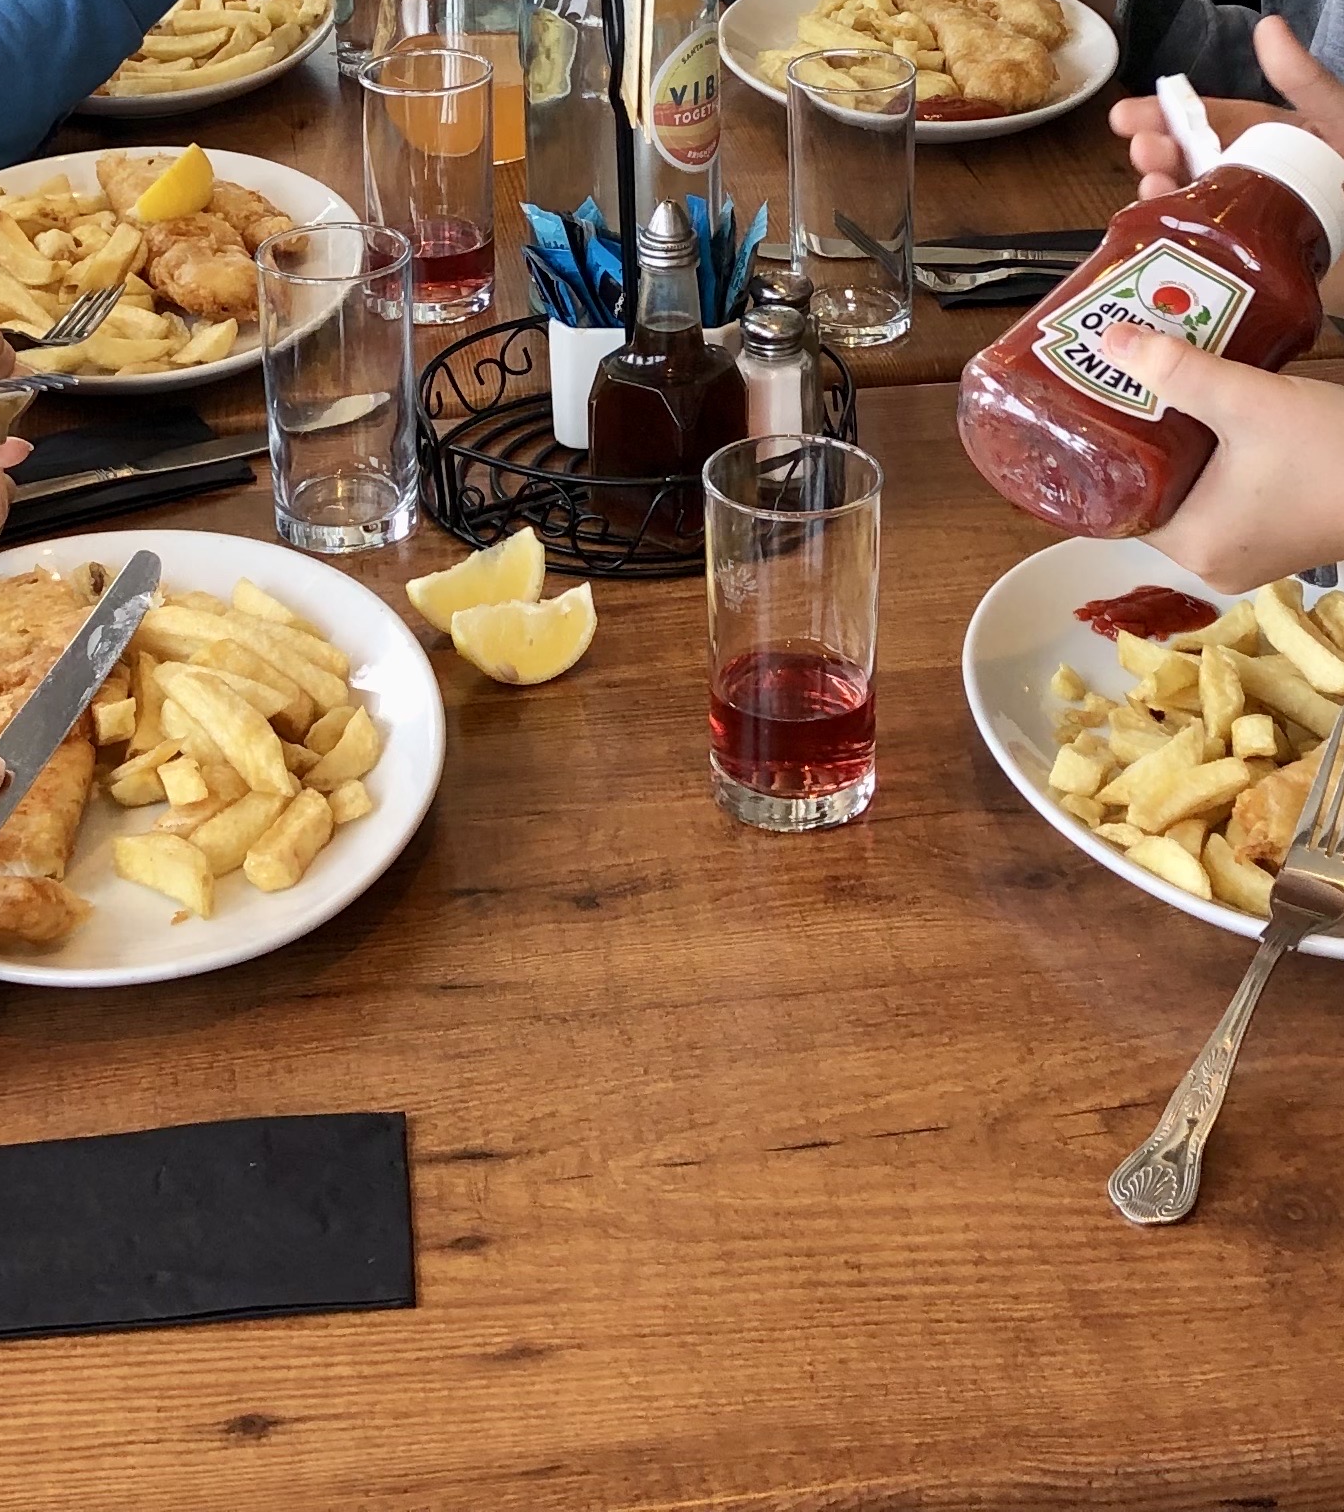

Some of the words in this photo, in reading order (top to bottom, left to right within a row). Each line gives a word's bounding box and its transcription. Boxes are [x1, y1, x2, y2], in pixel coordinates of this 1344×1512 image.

[681, 43, 704, 65] SANTA
[669, 73, 719, 106] VIB
[1064, 343, 1143, 398] HEINZ
